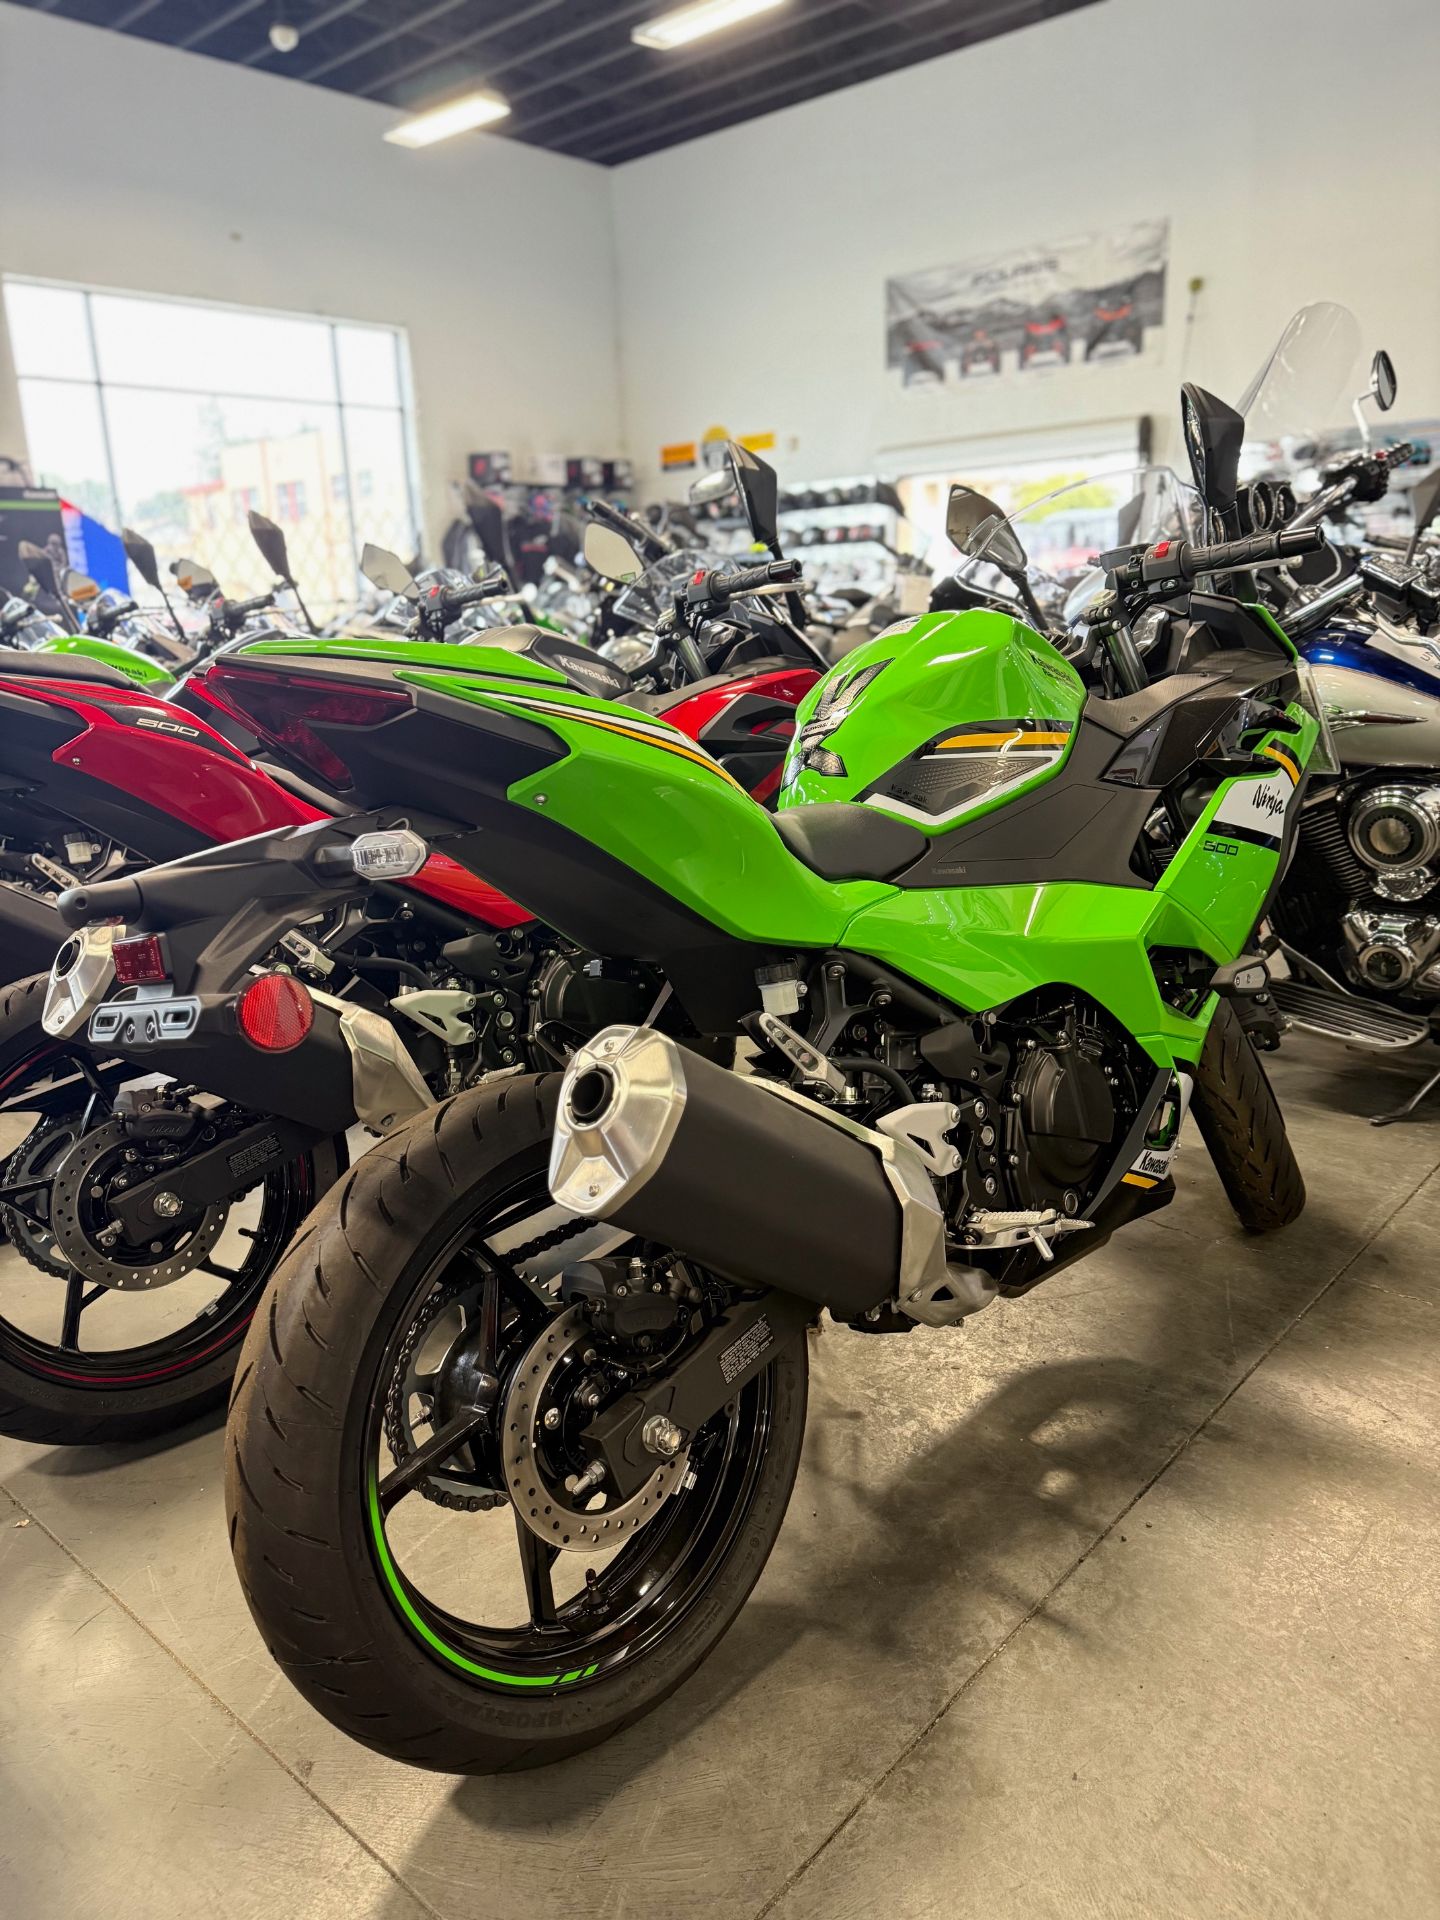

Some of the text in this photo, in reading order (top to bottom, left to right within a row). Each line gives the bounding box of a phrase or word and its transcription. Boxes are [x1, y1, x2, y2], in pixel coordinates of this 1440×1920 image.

[559, 655, 621, 689] Kawasaki
[136, 718, 200, 737] 500
[1252, 783, 1285, 819] Ninja
[1203, 840, 1239, 856] 500
